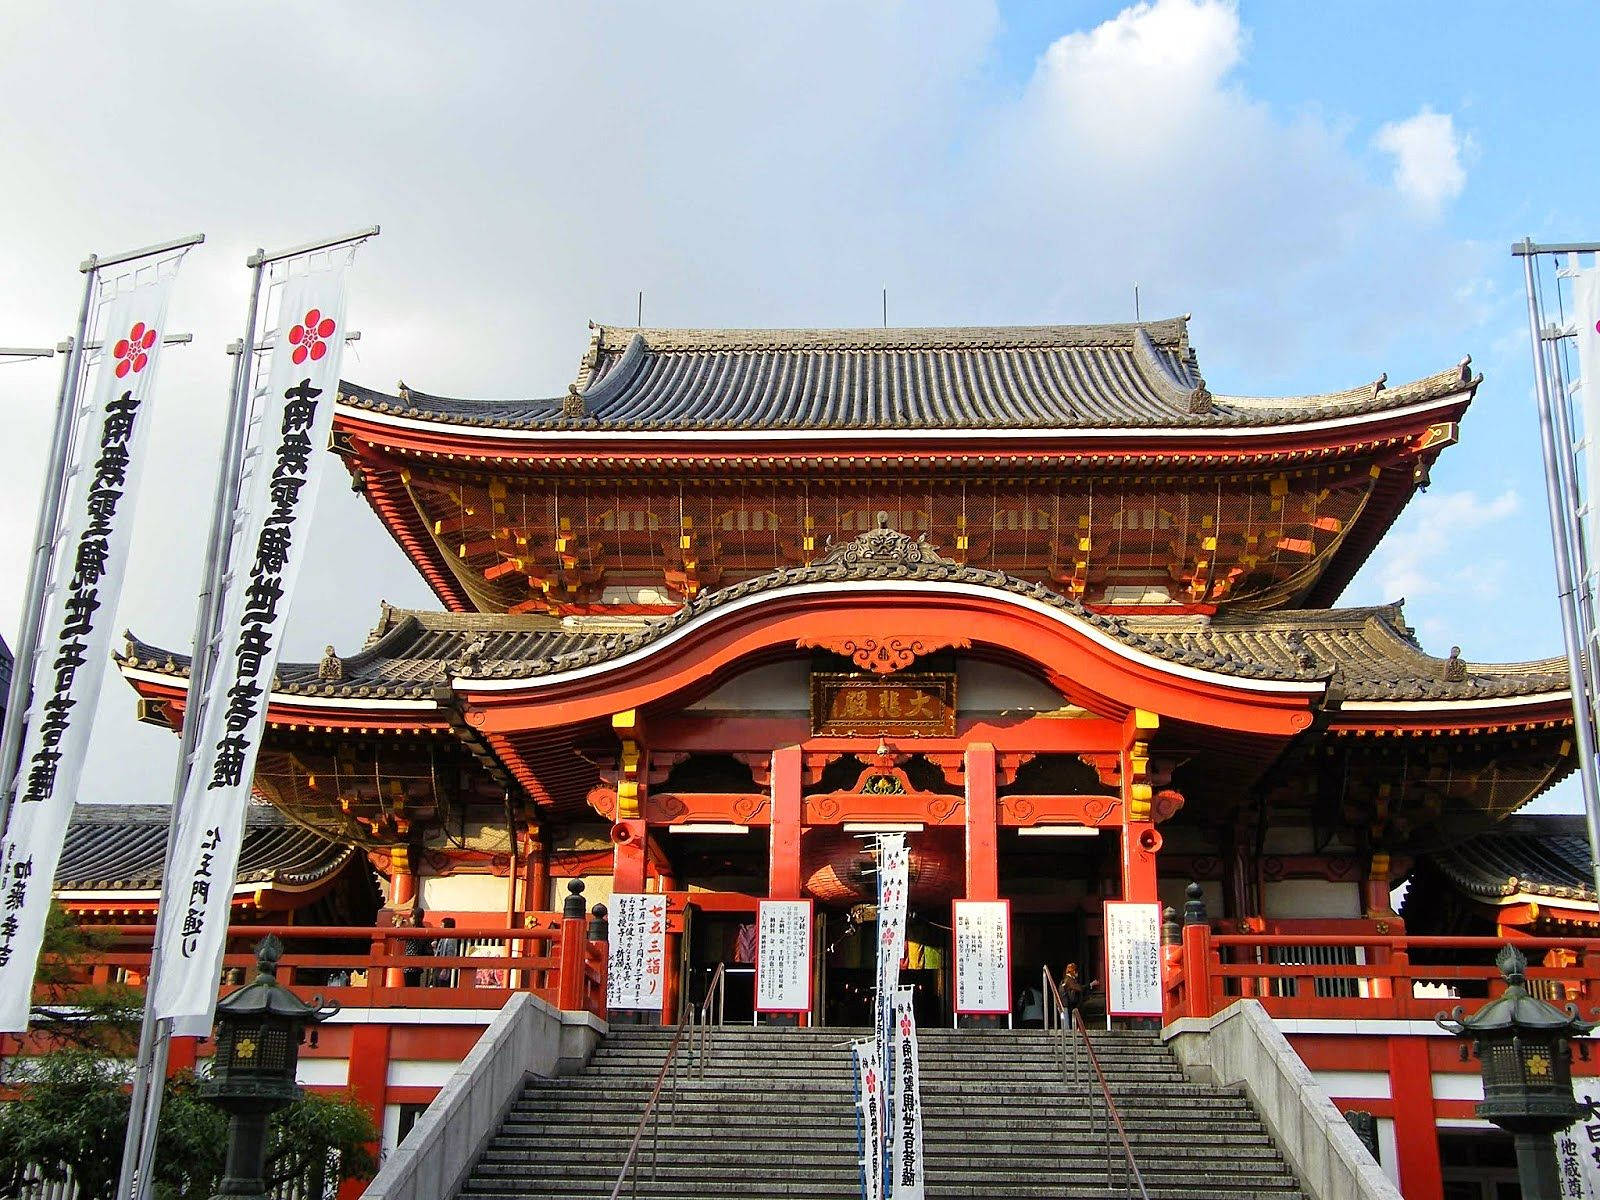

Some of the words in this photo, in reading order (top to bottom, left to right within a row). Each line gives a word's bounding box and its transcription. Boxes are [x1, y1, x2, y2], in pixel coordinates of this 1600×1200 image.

[646, 905, 663, 995] 七五三詣り
